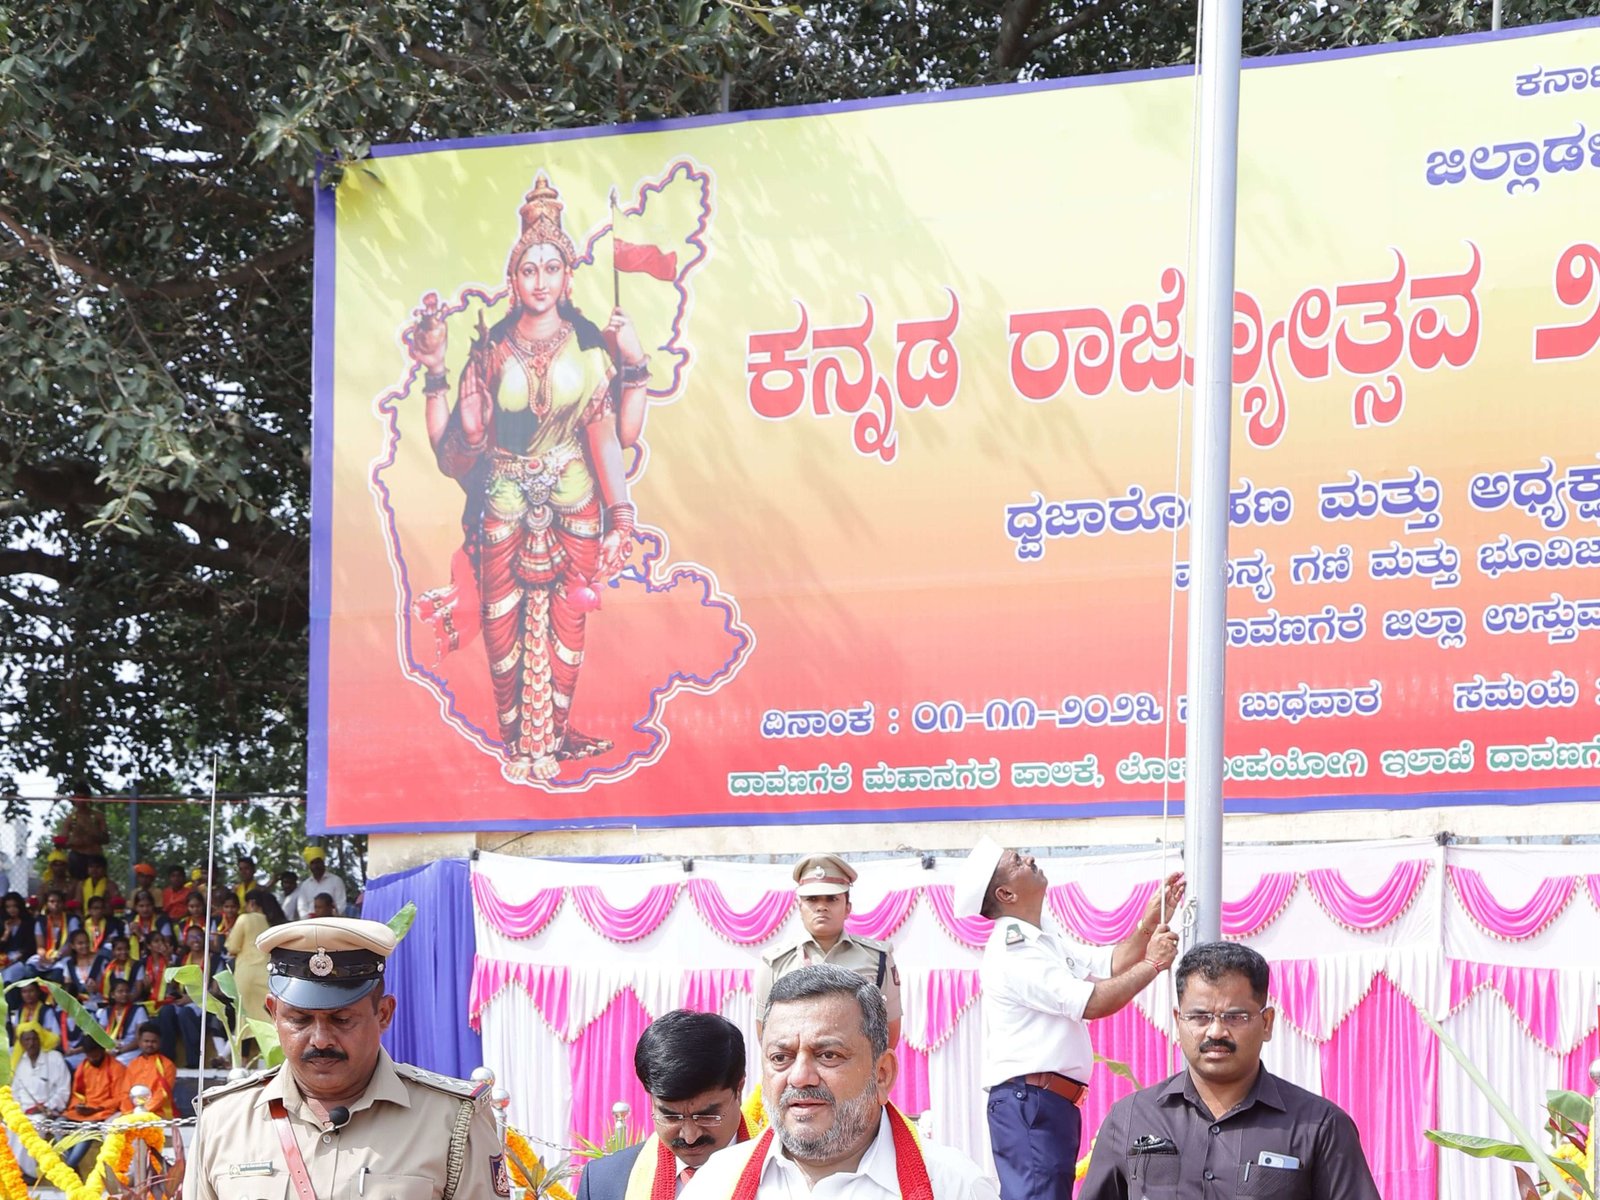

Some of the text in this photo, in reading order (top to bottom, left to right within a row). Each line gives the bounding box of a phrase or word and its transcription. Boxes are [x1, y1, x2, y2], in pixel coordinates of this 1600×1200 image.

[748, 287, 960, 463] ಕನ್ನಡ
[1321, 468, 1440, 531] ಮತ್ತು
[1293, 547, 1351, 582] ಗಣಿ
[1372, 541, 1459, 586] ಮತ್ತು
[1225, 606, 1365, 645] ಾವಣಗೆರೆ
[1385, 610, 1464, 646] ಜಿಲ್ಲಾ
[763, 705, 873, 736] ದಿನಾಂಕ
[1242, 682, 1380, 721] ಬುಧವಾರ
[1456, 674, 1577, 709] ಸಮಯ
[730, 764, 851, 794] ದಾವಣಗೆರೆ
[864, 759, 998, 791] ಮಹಾನಗರ
[1013, 755, 1103, 785] ಪಾಲಿಕೆ,
[1382, 742, 1473, 775] ಇಲಾಖೆ
